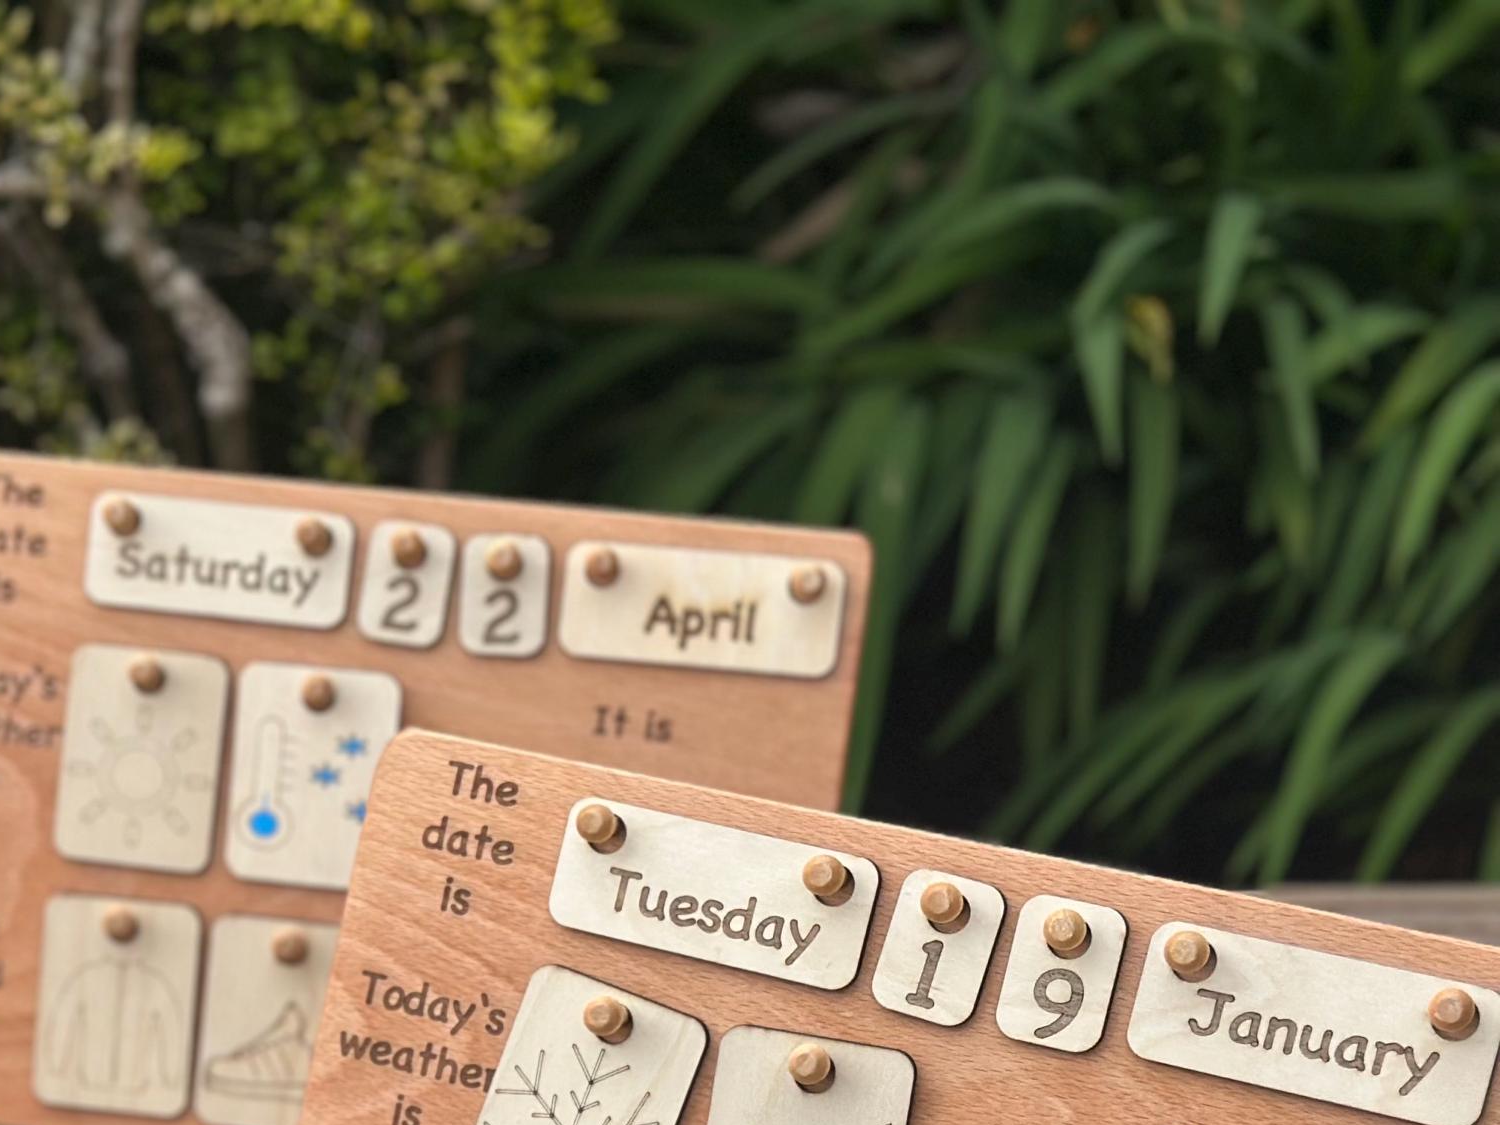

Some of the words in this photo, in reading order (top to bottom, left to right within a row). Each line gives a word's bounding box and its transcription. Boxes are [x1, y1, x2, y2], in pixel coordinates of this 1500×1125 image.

[114, 541, 321, 608] Saturday
[643, 596, 758, 651] April
[593, 705, 630, 737] It
[447, 760, 520, 808] The
[421, 815, 515, 866] date
[440, 876, 471, 917] is
[362, 970, 507, 1036] Today's
[609, 866, 821, 966] Tuesday
[1187, 986, 1441, 1097] January
